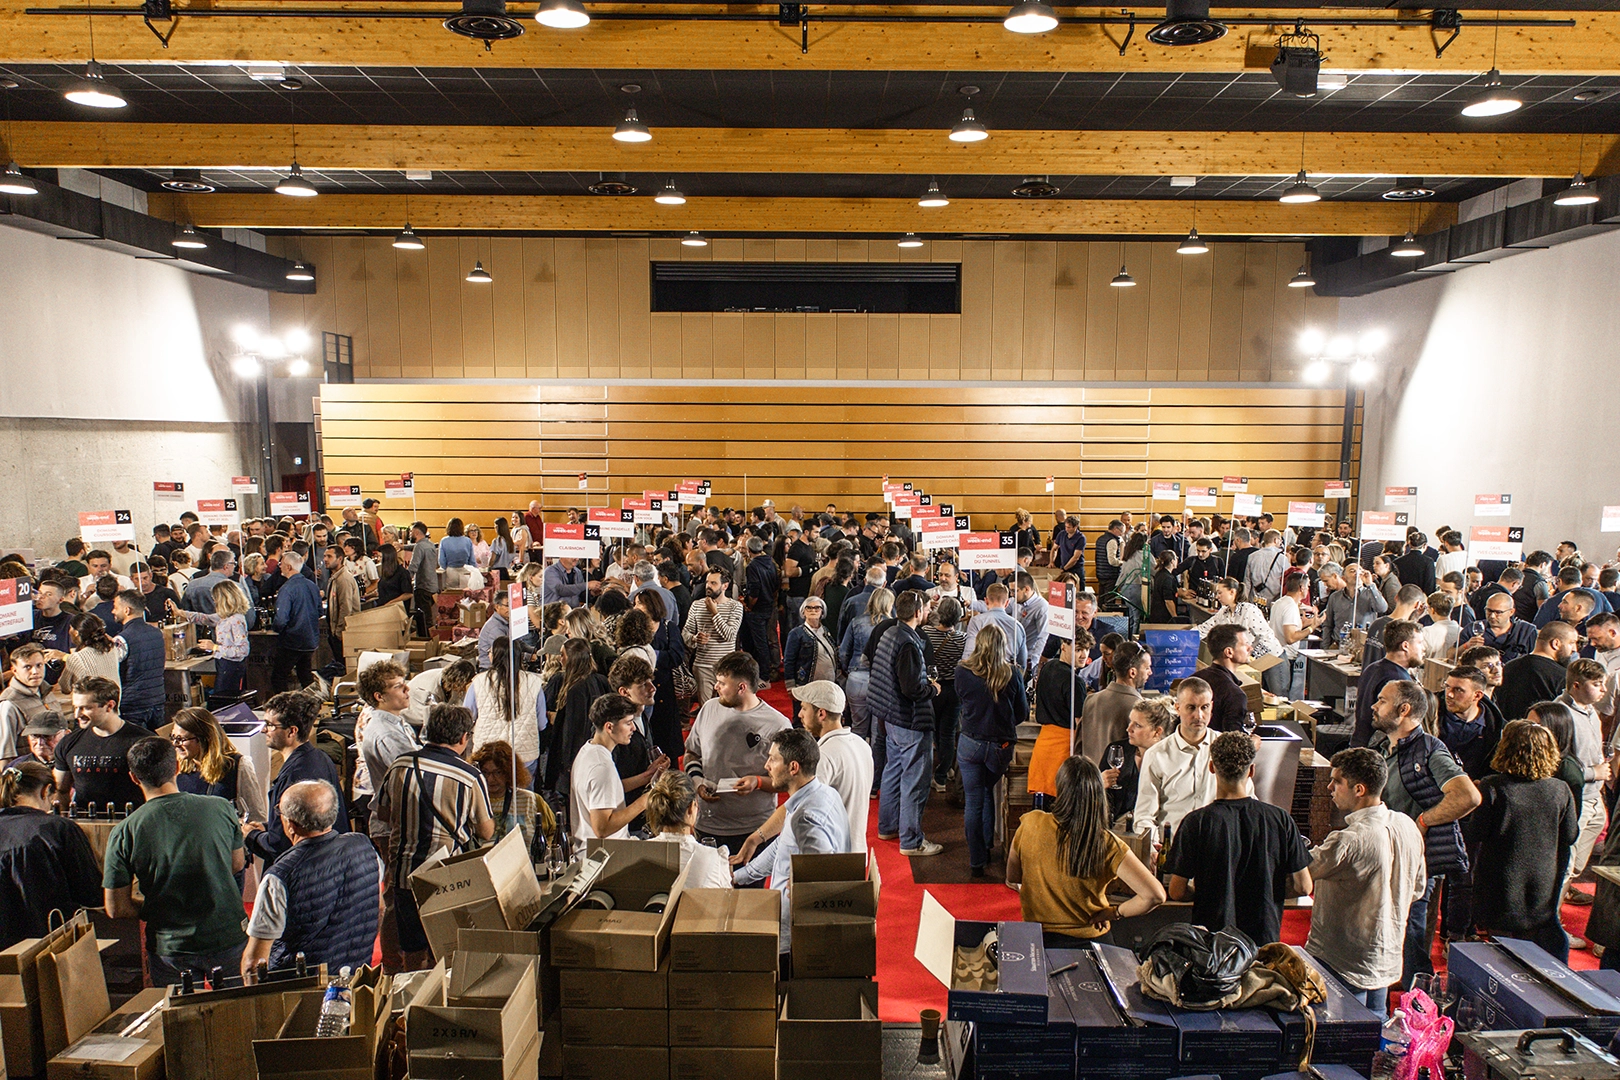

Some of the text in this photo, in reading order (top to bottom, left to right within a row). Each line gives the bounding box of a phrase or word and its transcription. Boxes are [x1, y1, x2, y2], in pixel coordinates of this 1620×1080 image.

[117, 513, 130, 521] 24
[956, 519, 966, 527] 36
[585, 528, 598, 537] 34
[1508, 530, 1521, 539] 46
[1001, 536, 1013, 545] 35
[18, 582, 30, 596] 20
[450, 883, 456, 891] 3
[456, 879, 471, 890] R/V
[837, 900, 853, 908] R/V
[433, 1028, 478, 1038] 2 X 3 R/V
